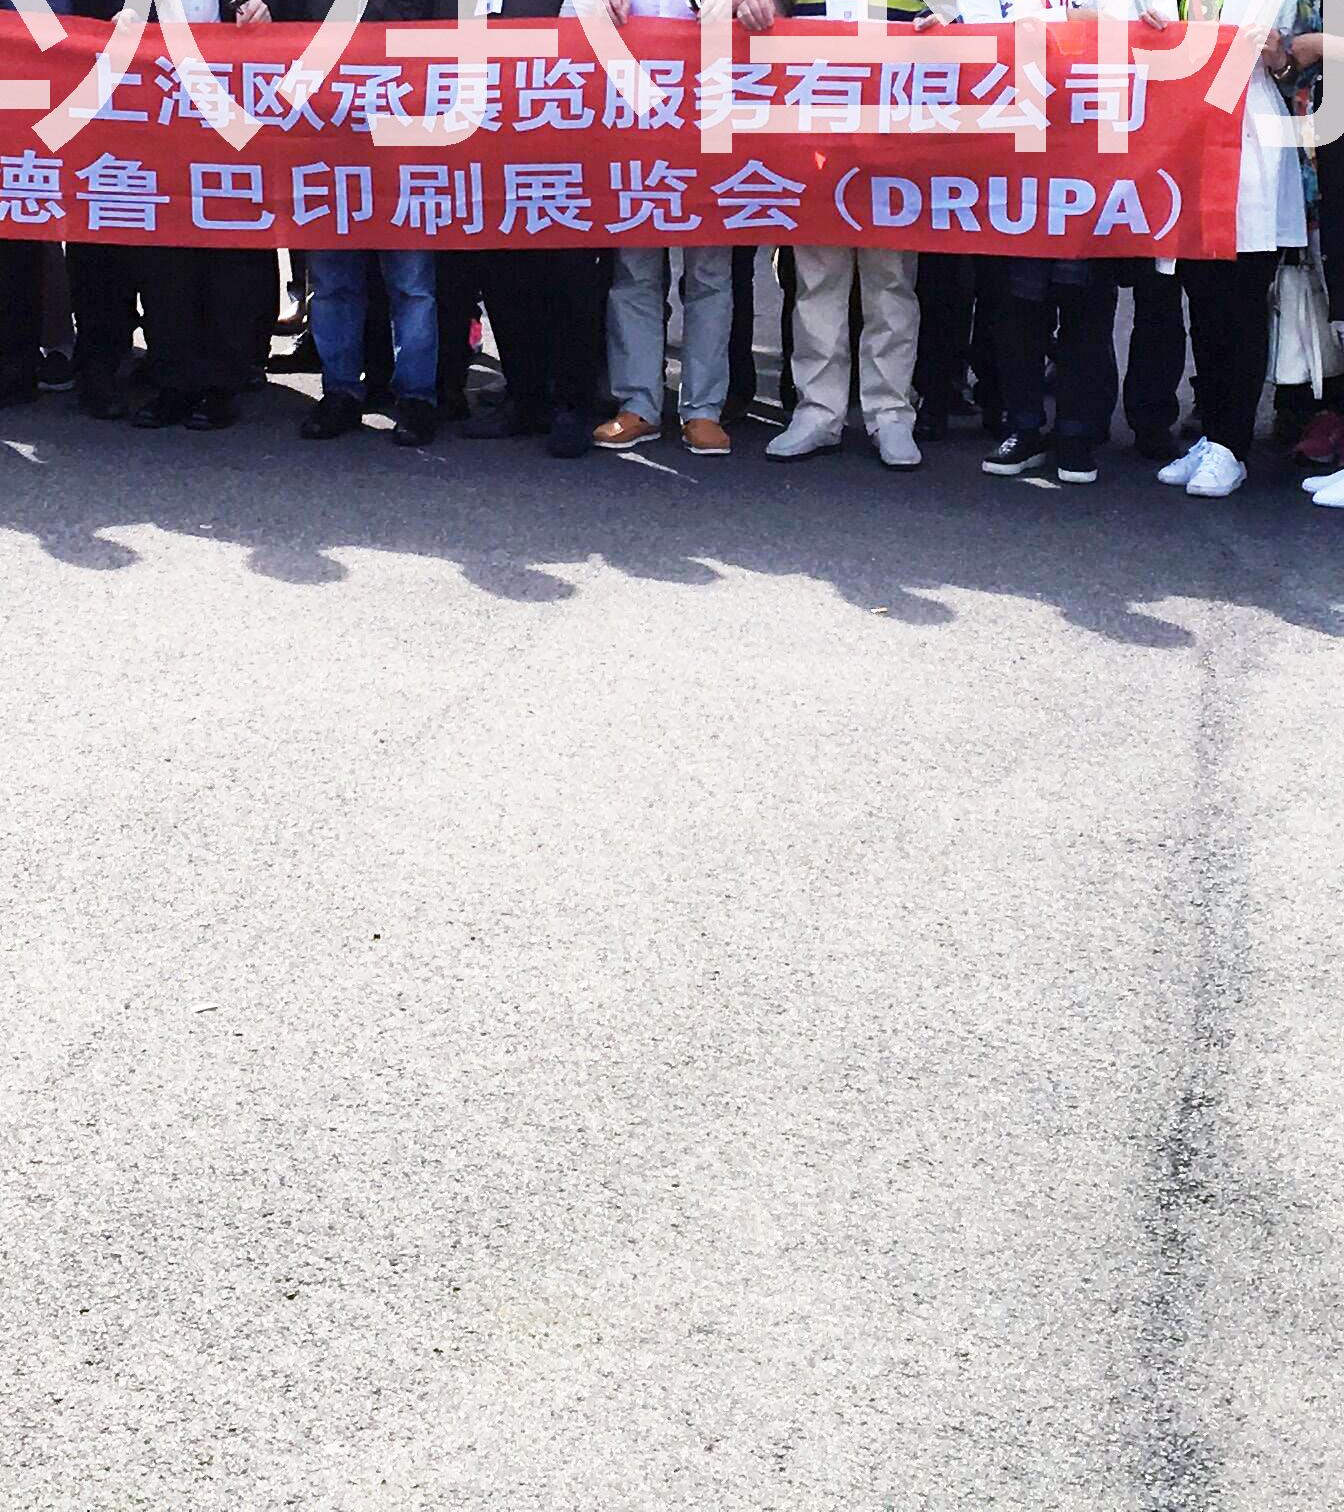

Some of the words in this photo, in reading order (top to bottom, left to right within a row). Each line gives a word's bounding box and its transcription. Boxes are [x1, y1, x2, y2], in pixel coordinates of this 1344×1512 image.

[68, 52, 1149, 134] 上海欧承展览服务有限公司
